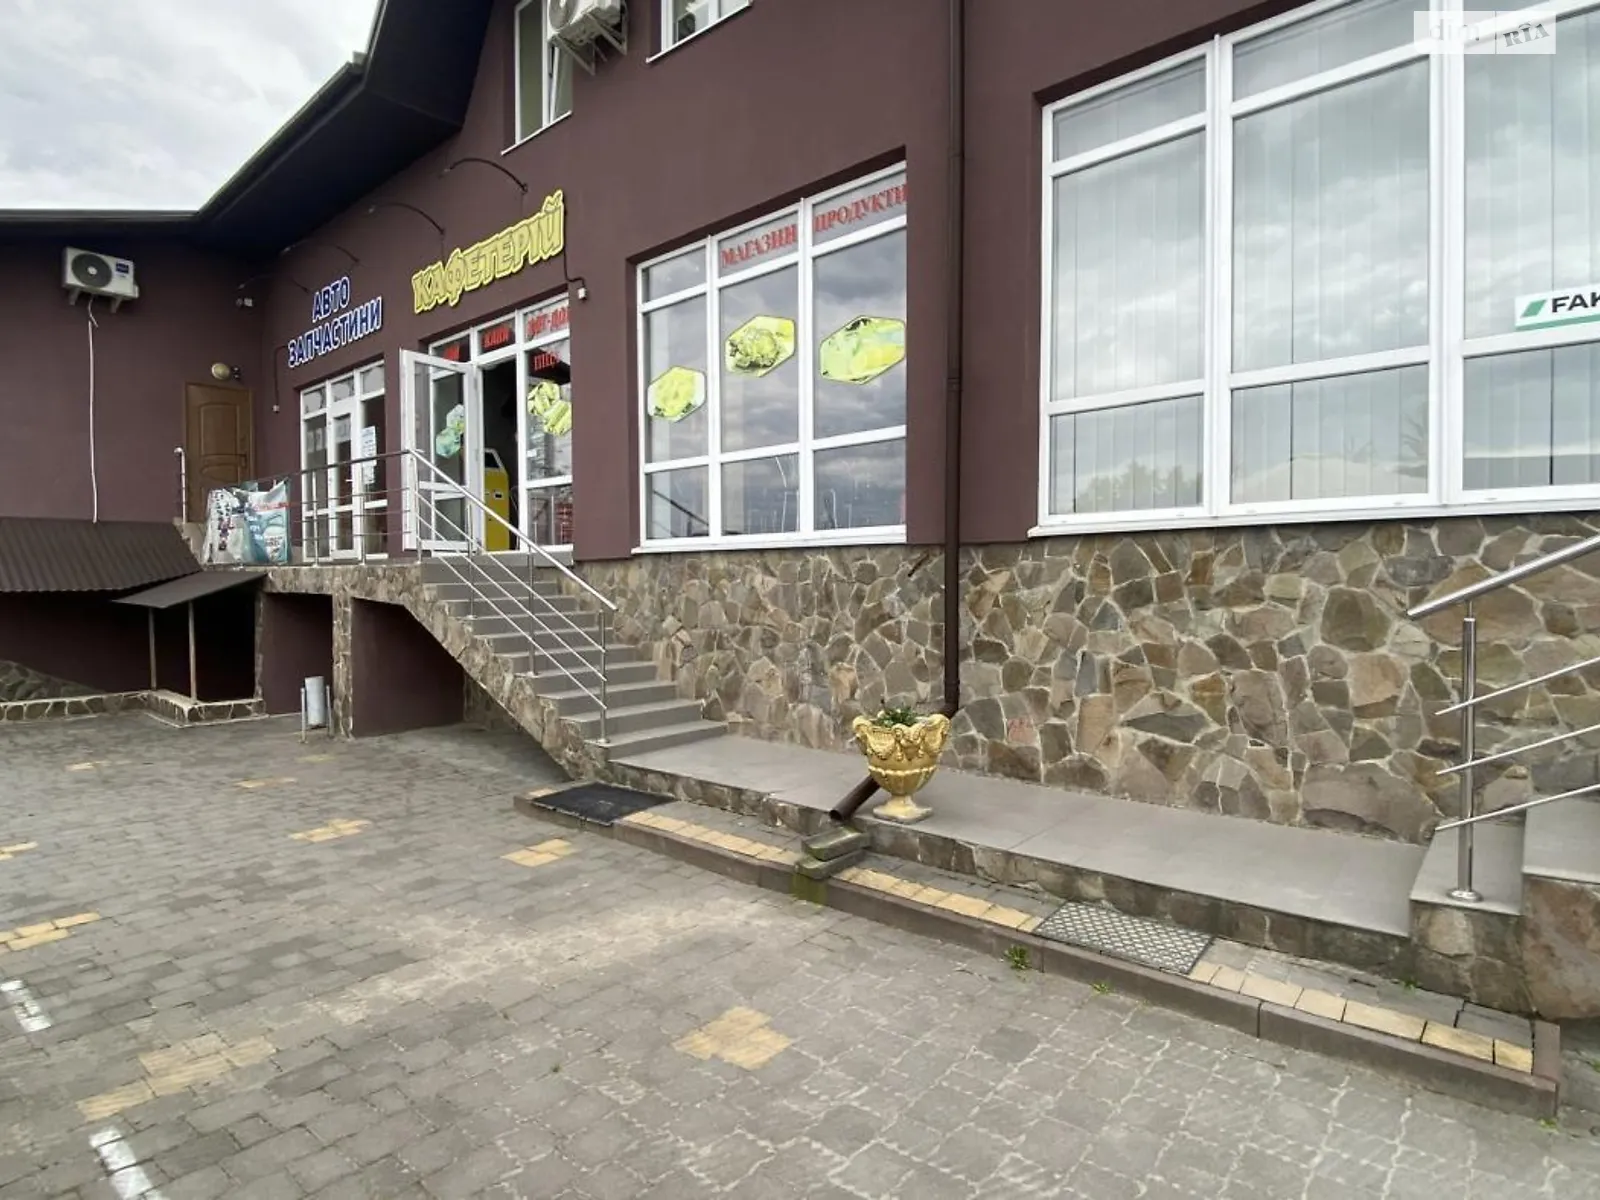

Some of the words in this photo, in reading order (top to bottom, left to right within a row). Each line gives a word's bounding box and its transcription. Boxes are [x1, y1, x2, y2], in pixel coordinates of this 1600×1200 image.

[412, 189, 565, 314] КАФЕТЕРІЙ
[720, 223, 797, 268] МАГАЗИН
[312, 276, 350, 323] АВТО
[288, 296, 382, 368] ЗАПЧАСТИНИ
